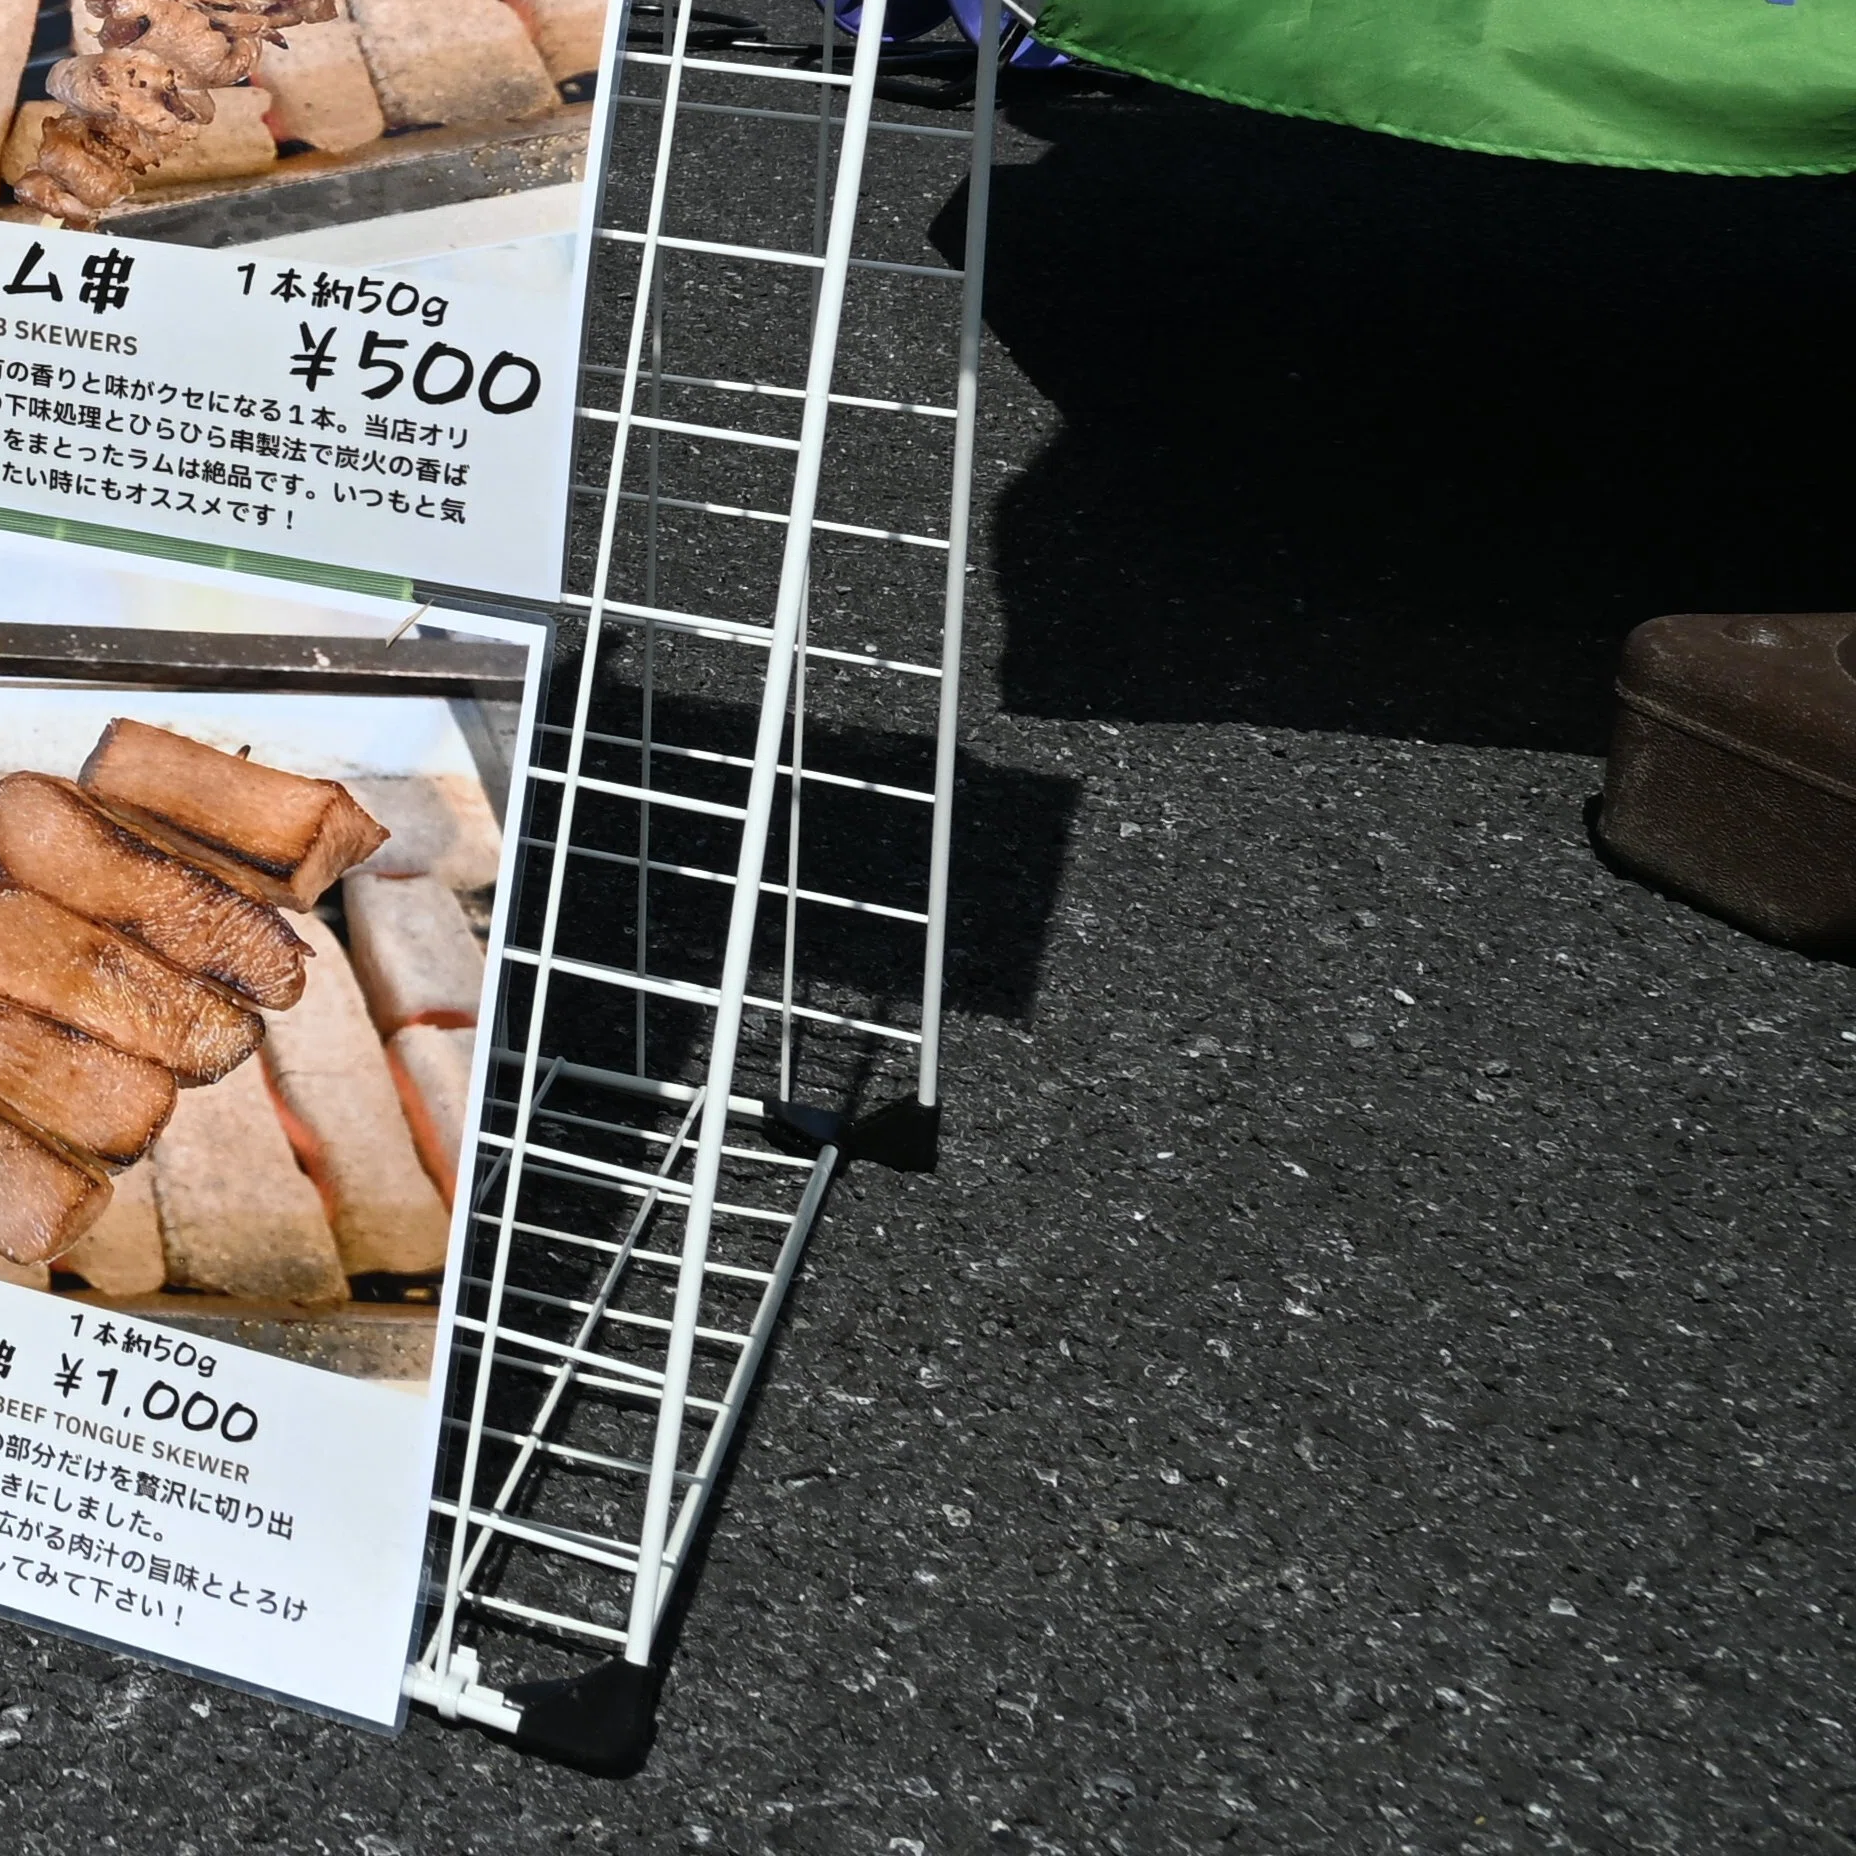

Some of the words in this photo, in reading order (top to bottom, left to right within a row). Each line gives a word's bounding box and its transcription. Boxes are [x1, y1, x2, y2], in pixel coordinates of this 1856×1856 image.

[236, 262, 450, 328] 1本約50g
[14, 320, 138, 356] SKEWERS
[289, 320, 542, 416] ¥500
[70, 1313, 218, 1378] 1本約50g
[53, 1352, 259, 1443] ¥1,000
[53, 1411, 146, 1454] TONGUE
[151, 1440, 250, 1484] SKEWER
